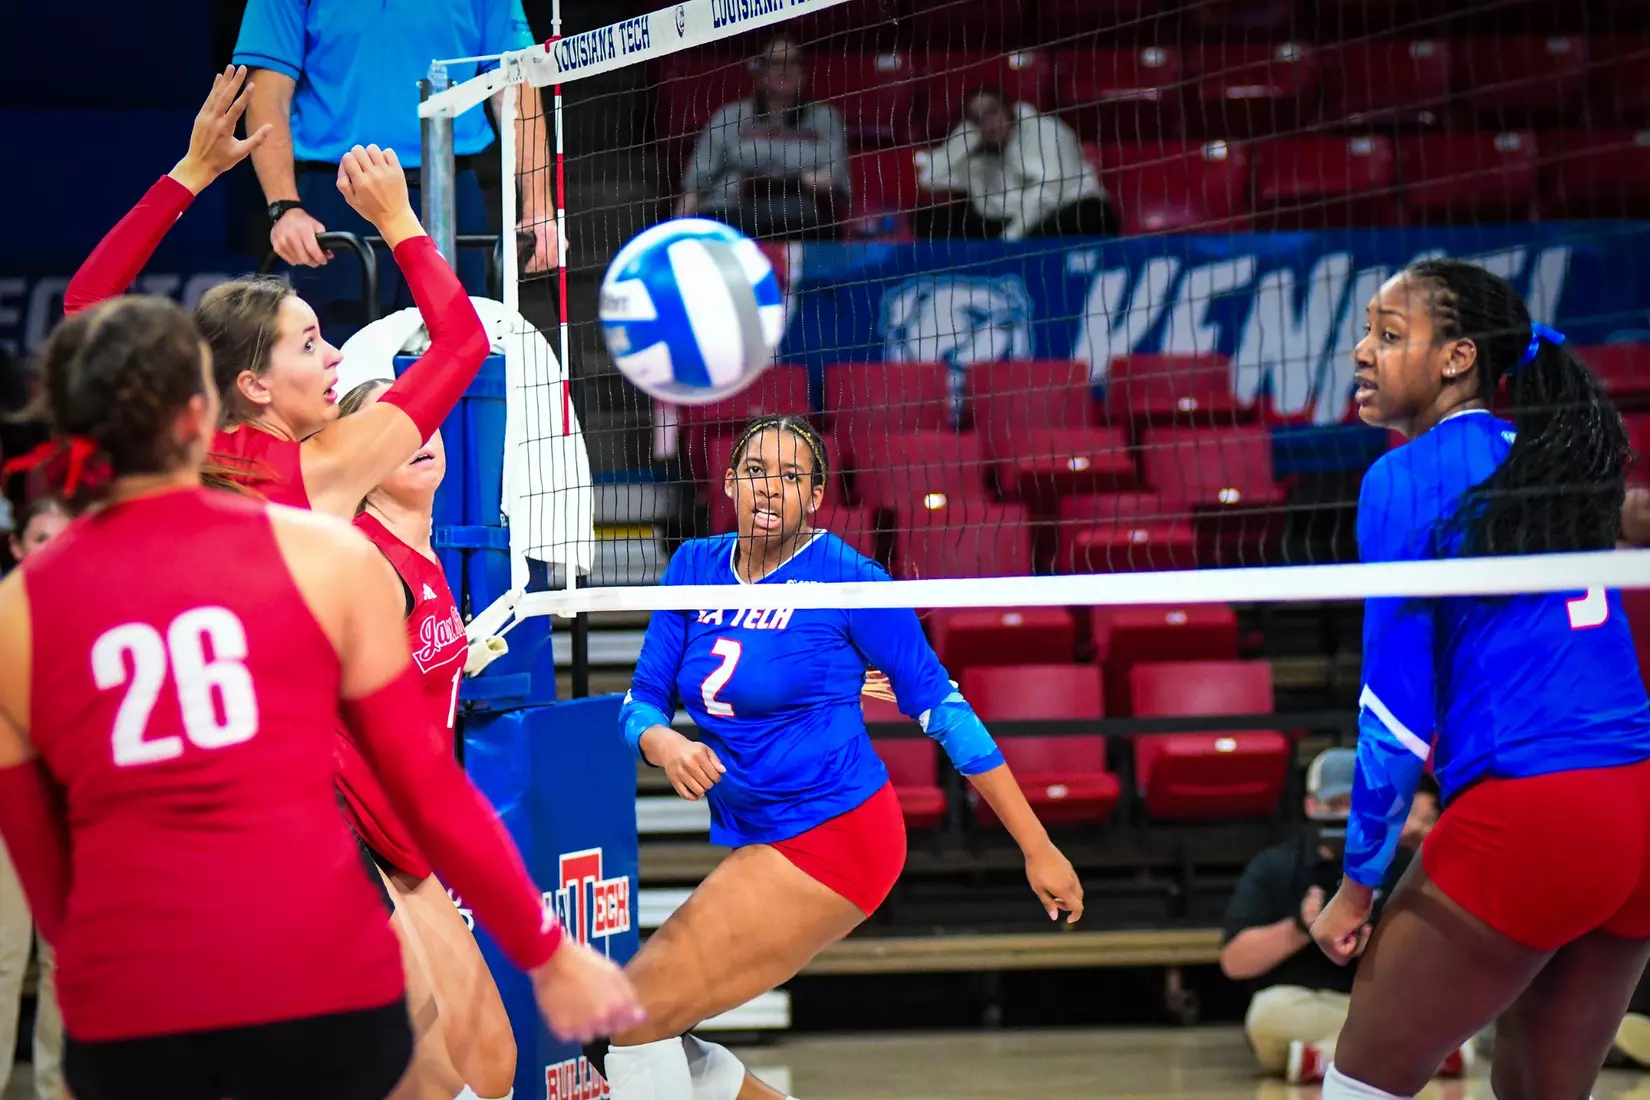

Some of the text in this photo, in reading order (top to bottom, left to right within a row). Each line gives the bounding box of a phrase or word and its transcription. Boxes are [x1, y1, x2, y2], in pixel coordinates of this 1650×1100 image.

[554, 15, 650, 73] LOUISIANA TECH
[711, 0, 783, 28] LOUISI
[91, 605, 259, 767] 26
[447, 667, 462, 729] 1
[700, 636, 743, 718] 2
[545, 1055, 611, 1100] BULLD
